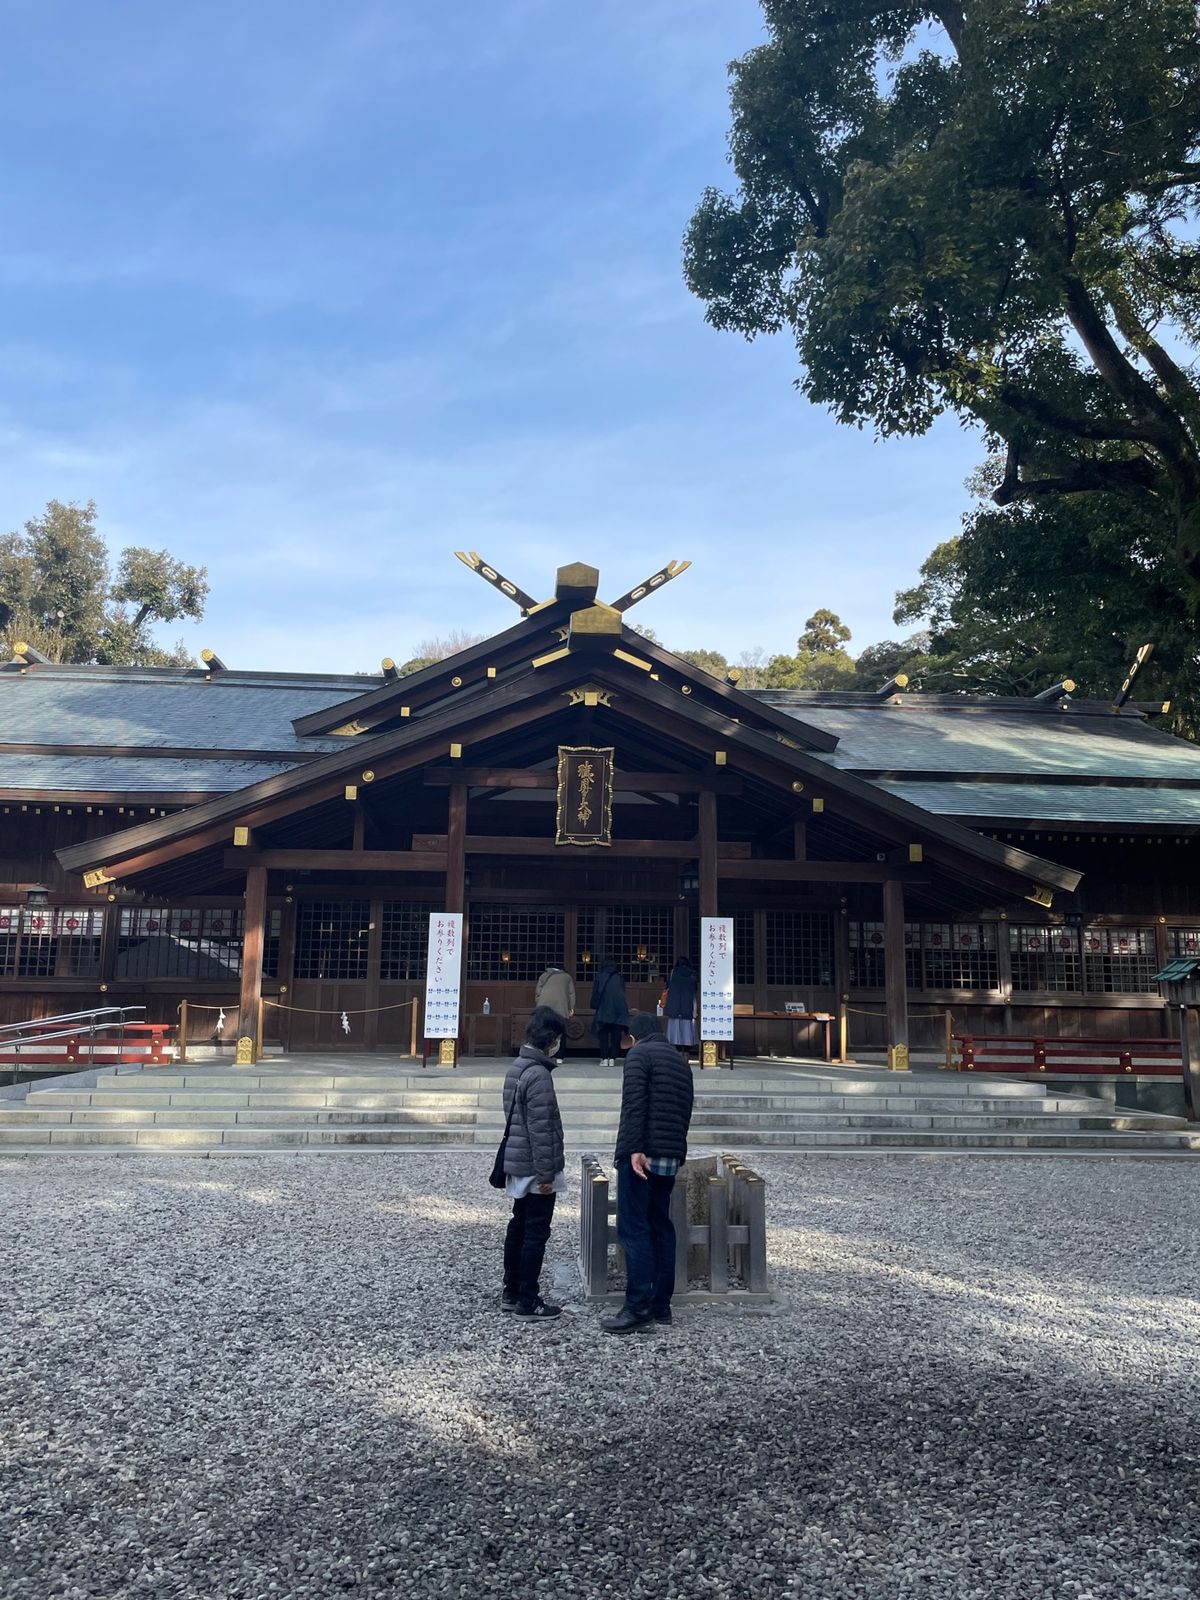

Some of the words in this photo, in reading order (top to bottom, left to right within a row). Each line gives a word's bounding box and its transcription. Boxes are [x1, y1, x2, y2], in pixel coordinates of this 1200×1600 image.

[434, 919, 444, 983] お参りください
[446, 919, 455, 956] 複数列で
[708, 924, 716, 986] お参りください
[718, 924, 727, 959] 複数列で
